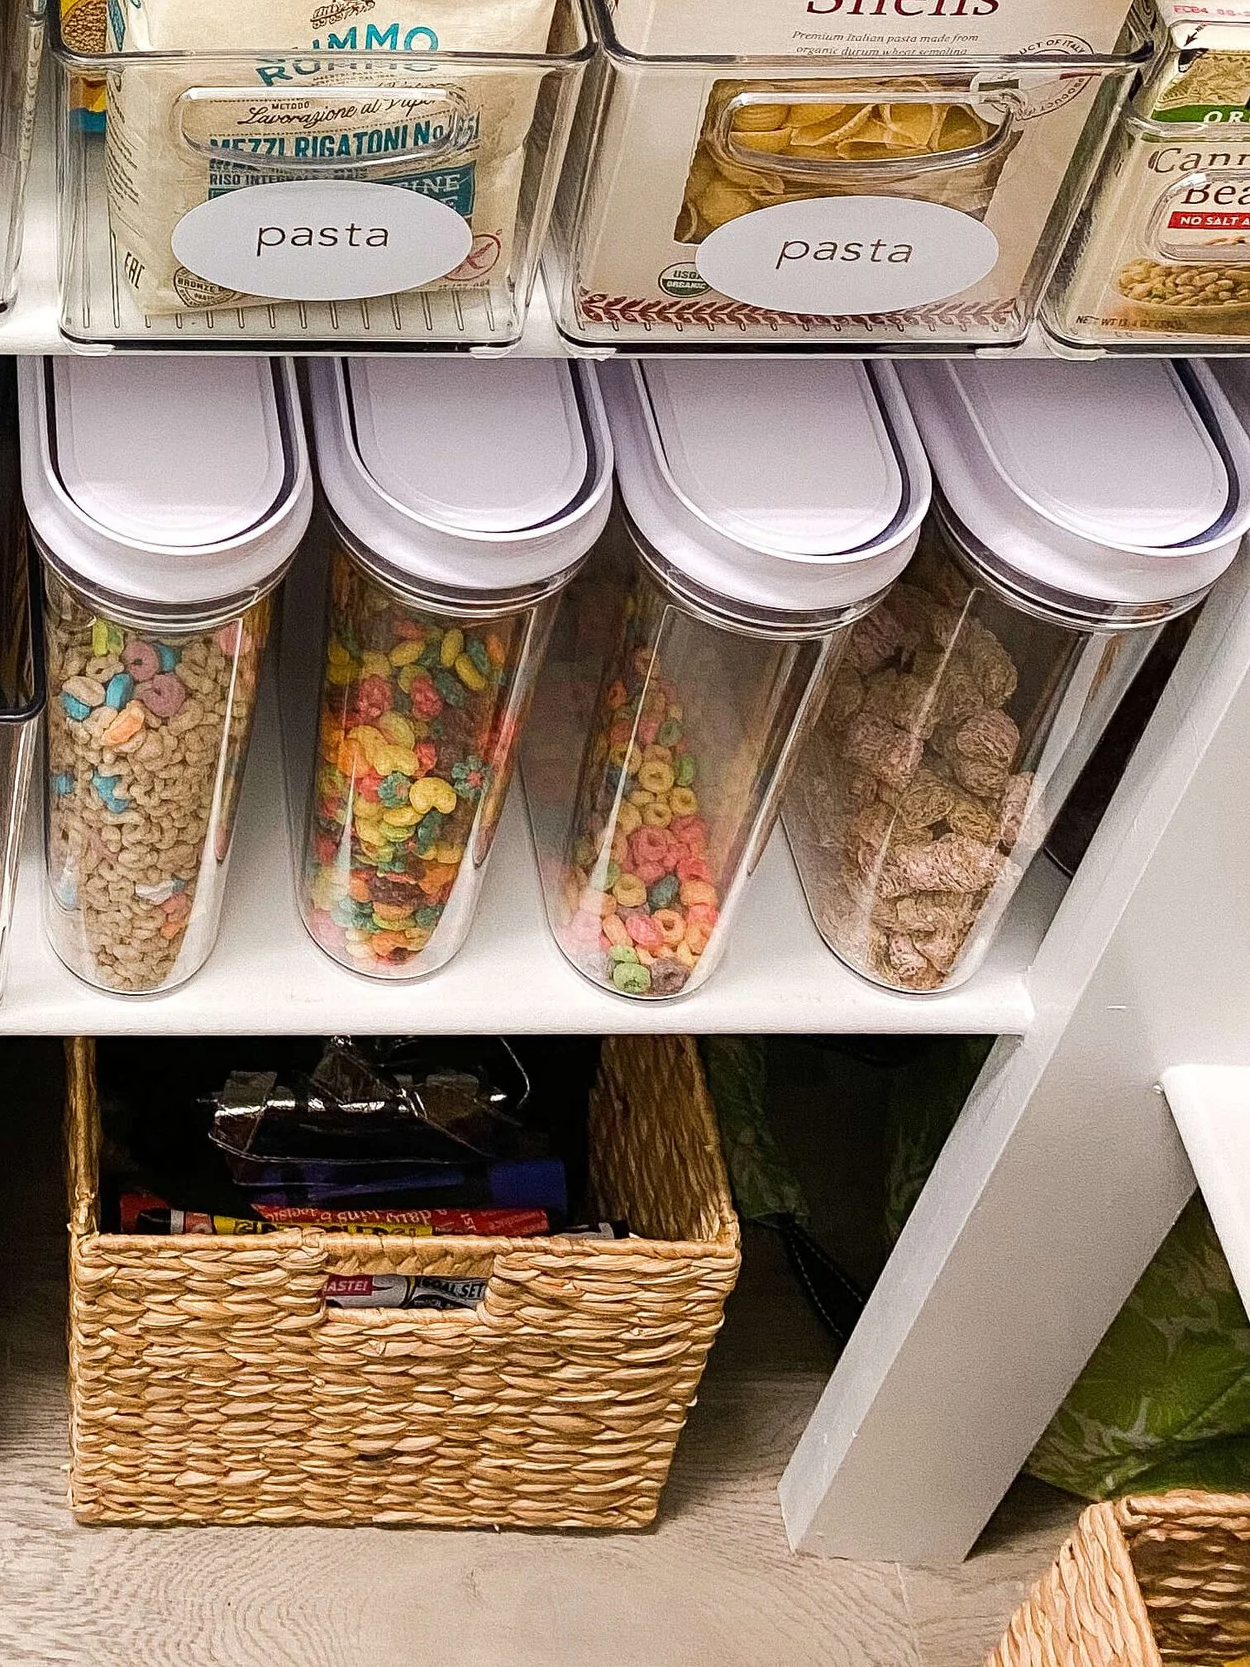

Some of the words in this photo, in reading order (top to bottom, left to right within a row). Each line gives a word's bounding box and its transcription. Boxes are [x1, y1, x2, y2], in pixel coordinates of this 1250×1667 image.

[256, 221, 390, 256] pasta
[1179, 214, 1204, 229] NO
[1207, 215, 1239, 229] SALT
[775, 234, 914, 270] pasta
